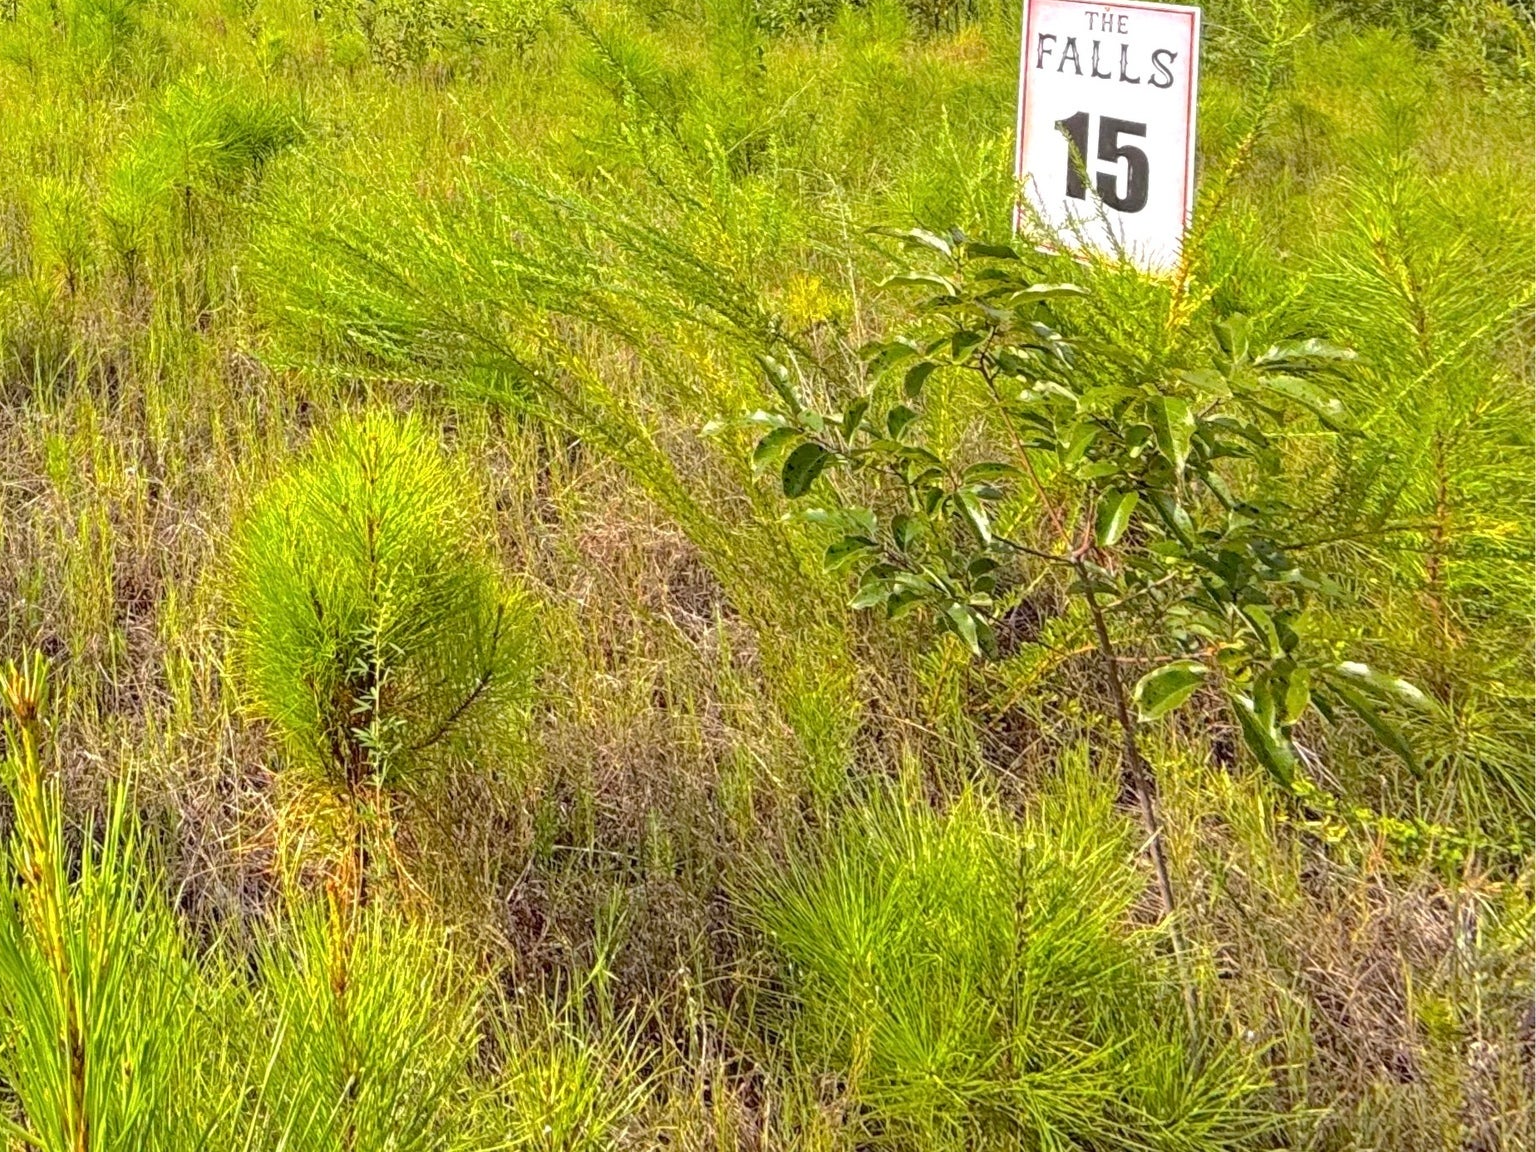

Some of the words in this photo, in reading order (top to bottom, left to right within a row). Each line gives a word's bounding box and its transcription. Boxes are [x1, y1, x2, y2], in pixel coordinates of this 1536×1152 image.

[1085, 11, 1129, 34] THE
[1036, 33, 1178, 89] FALLS
[1055, 111, 1150, 214] 15
